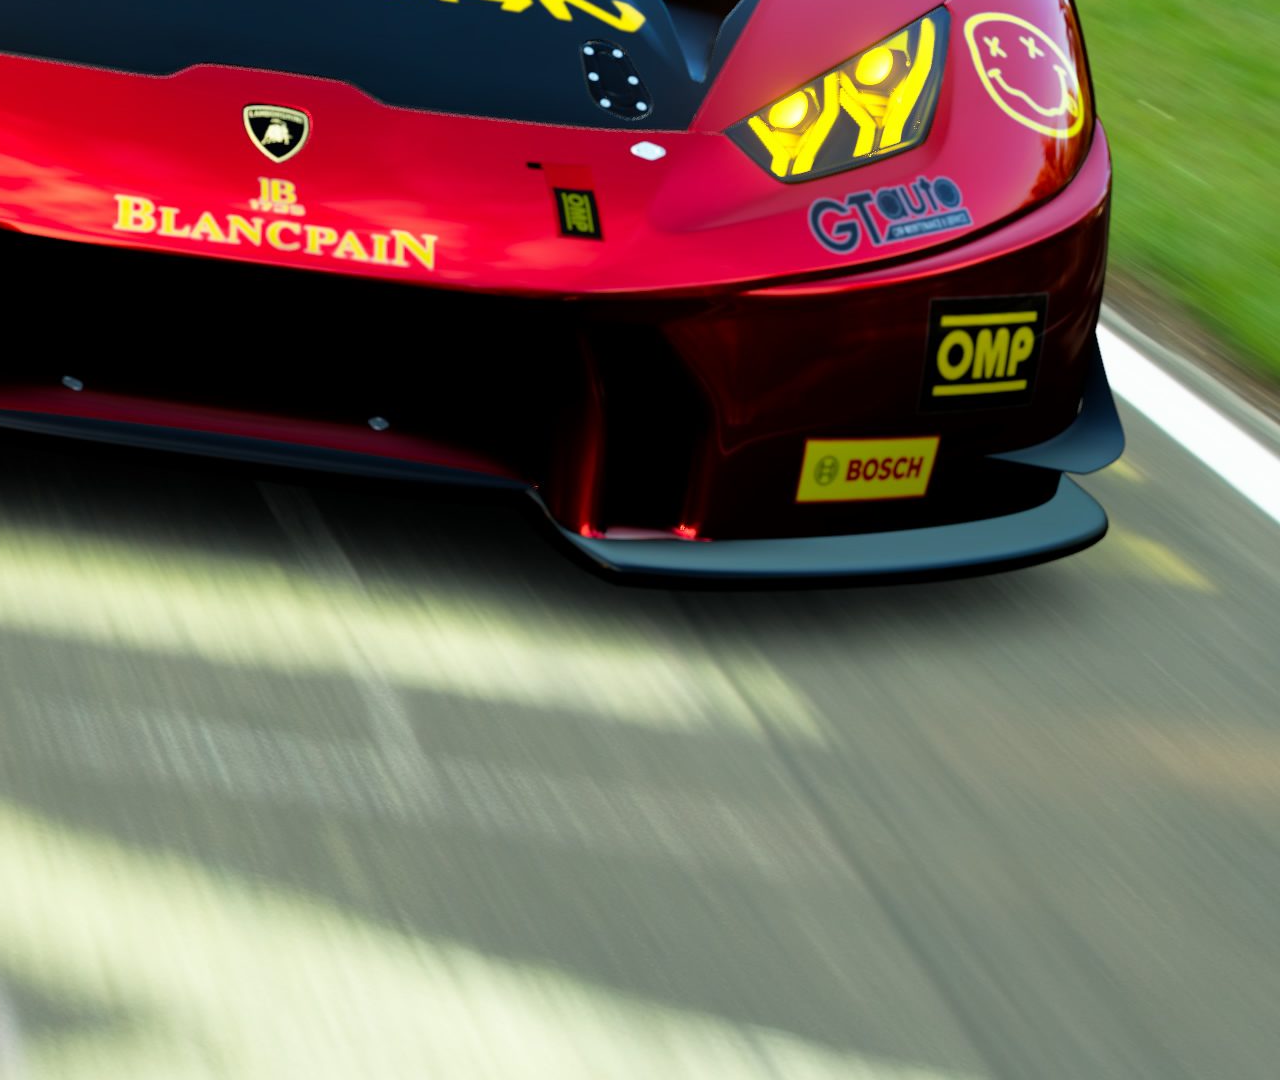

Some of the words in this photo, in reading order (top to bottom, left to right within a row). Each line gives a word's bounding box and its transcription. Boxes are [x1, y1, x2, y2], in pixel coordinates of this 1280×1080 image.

[112, 193, 439, 272] BLANCPAIN
[567, 193, 589, 232] OMP
[935, 326, 1036, 381] OMP
[845, 455, 924, 482] BOSCH
